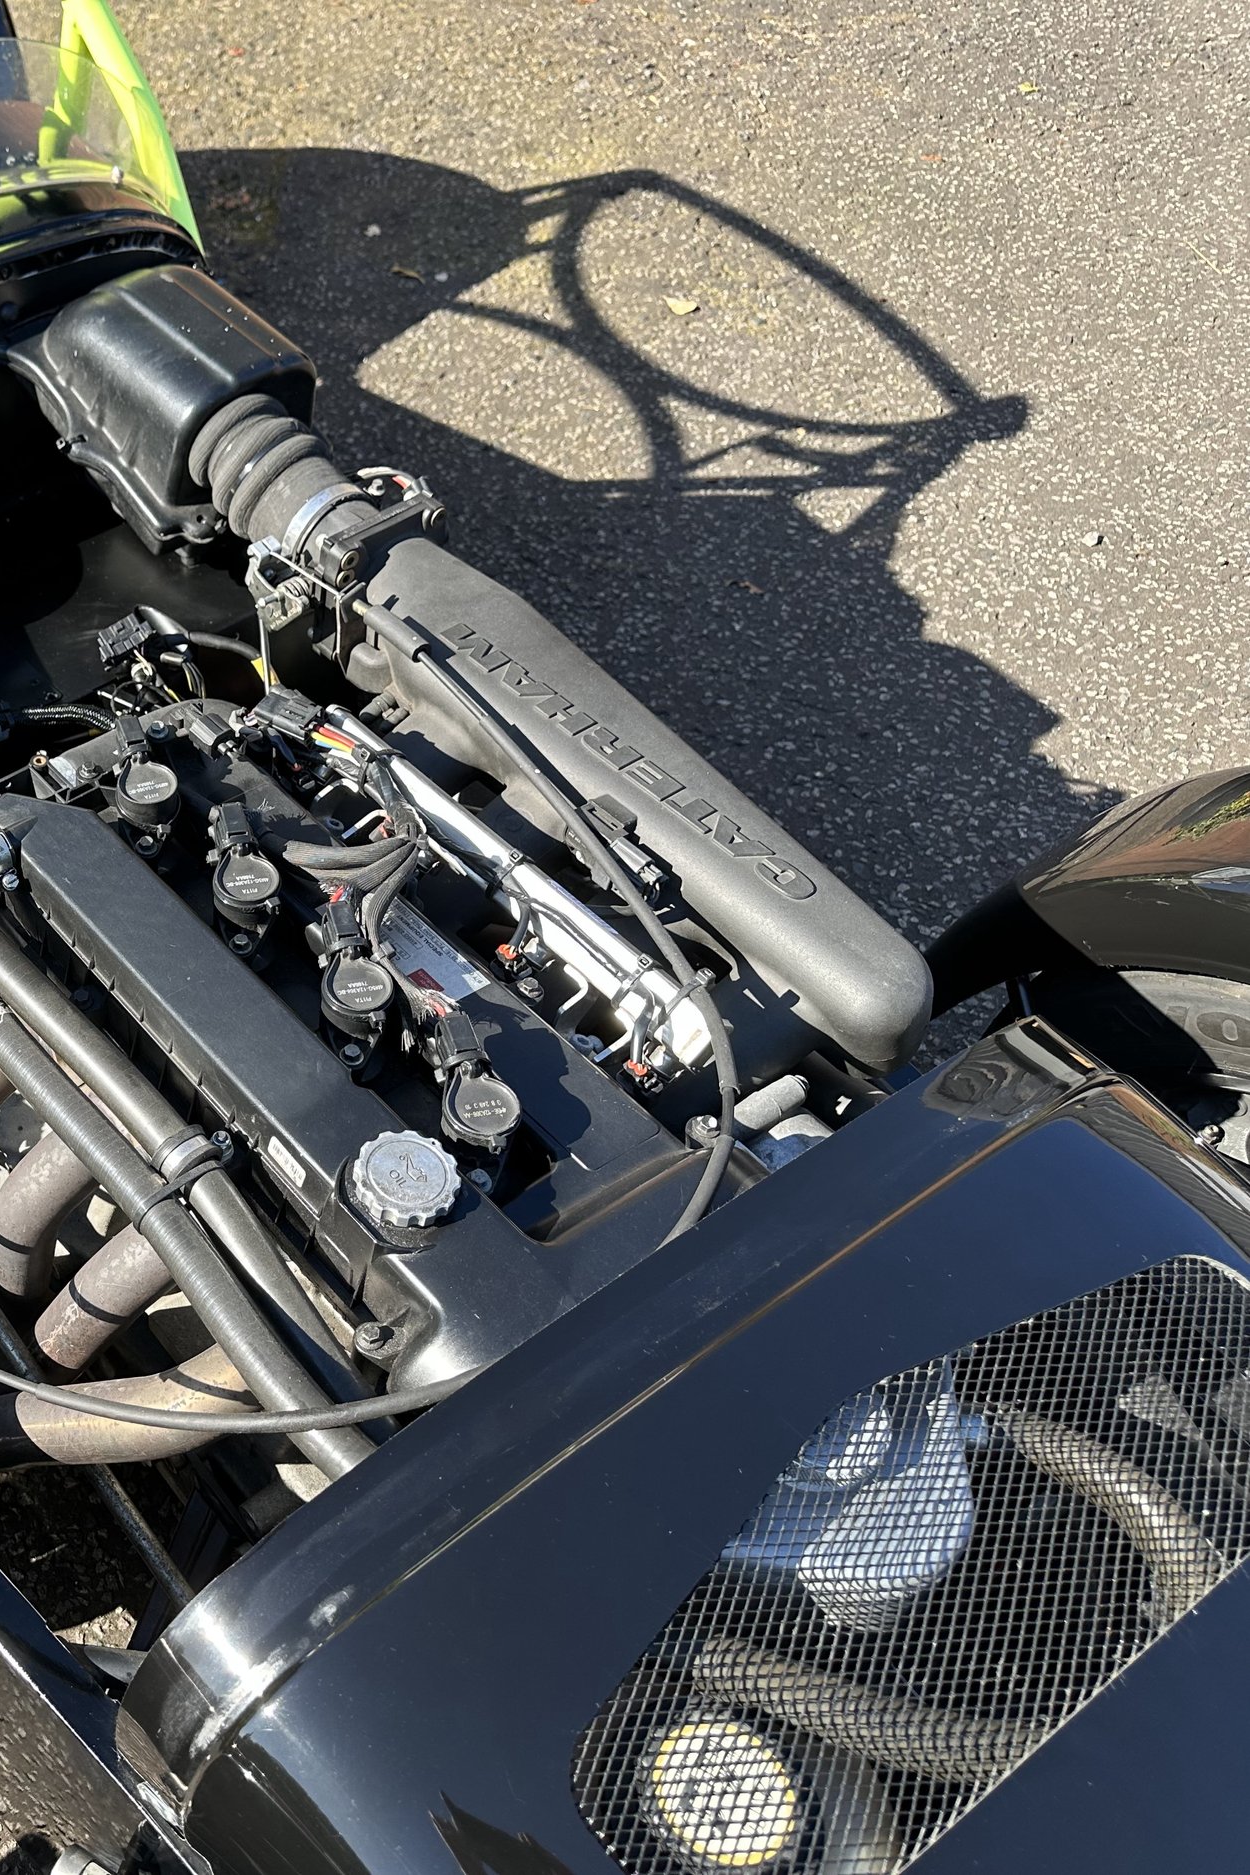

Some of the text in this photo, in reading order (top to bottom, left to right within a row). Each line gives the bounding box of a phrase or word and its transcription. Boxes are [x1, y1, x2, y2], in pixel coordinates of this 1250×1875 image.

[440, 623, 817, 900] CATERHAM
[395, 913, 424, 939] EQUIPMENT
[422, 937, 443, 957] SPECIAL
[389, 1169, 406, 1188] OIL
